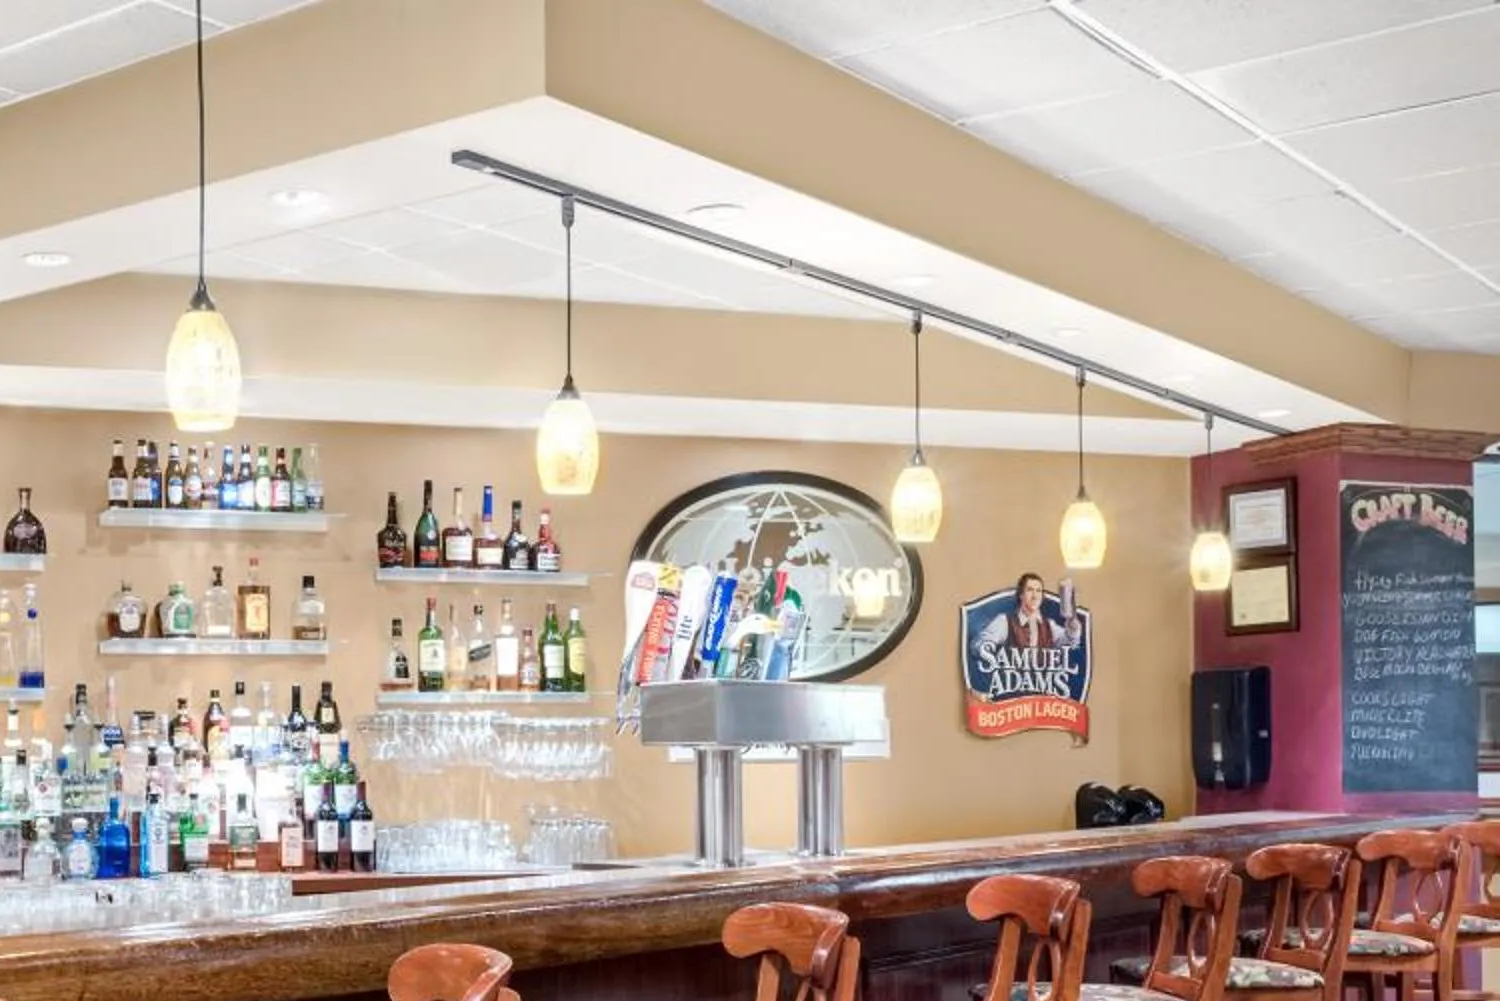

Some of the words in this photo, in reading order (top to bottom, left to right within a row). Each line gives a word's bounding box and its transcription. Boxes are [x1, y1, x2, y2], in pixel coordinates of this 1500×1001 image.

[977, 641, 1079, 674] SAMUEL
[987, 669, 1071, 698] ADAMS
[978, 703, 1033, 727] BOSTON
[1034, 701, 1079, 723] LAGER
